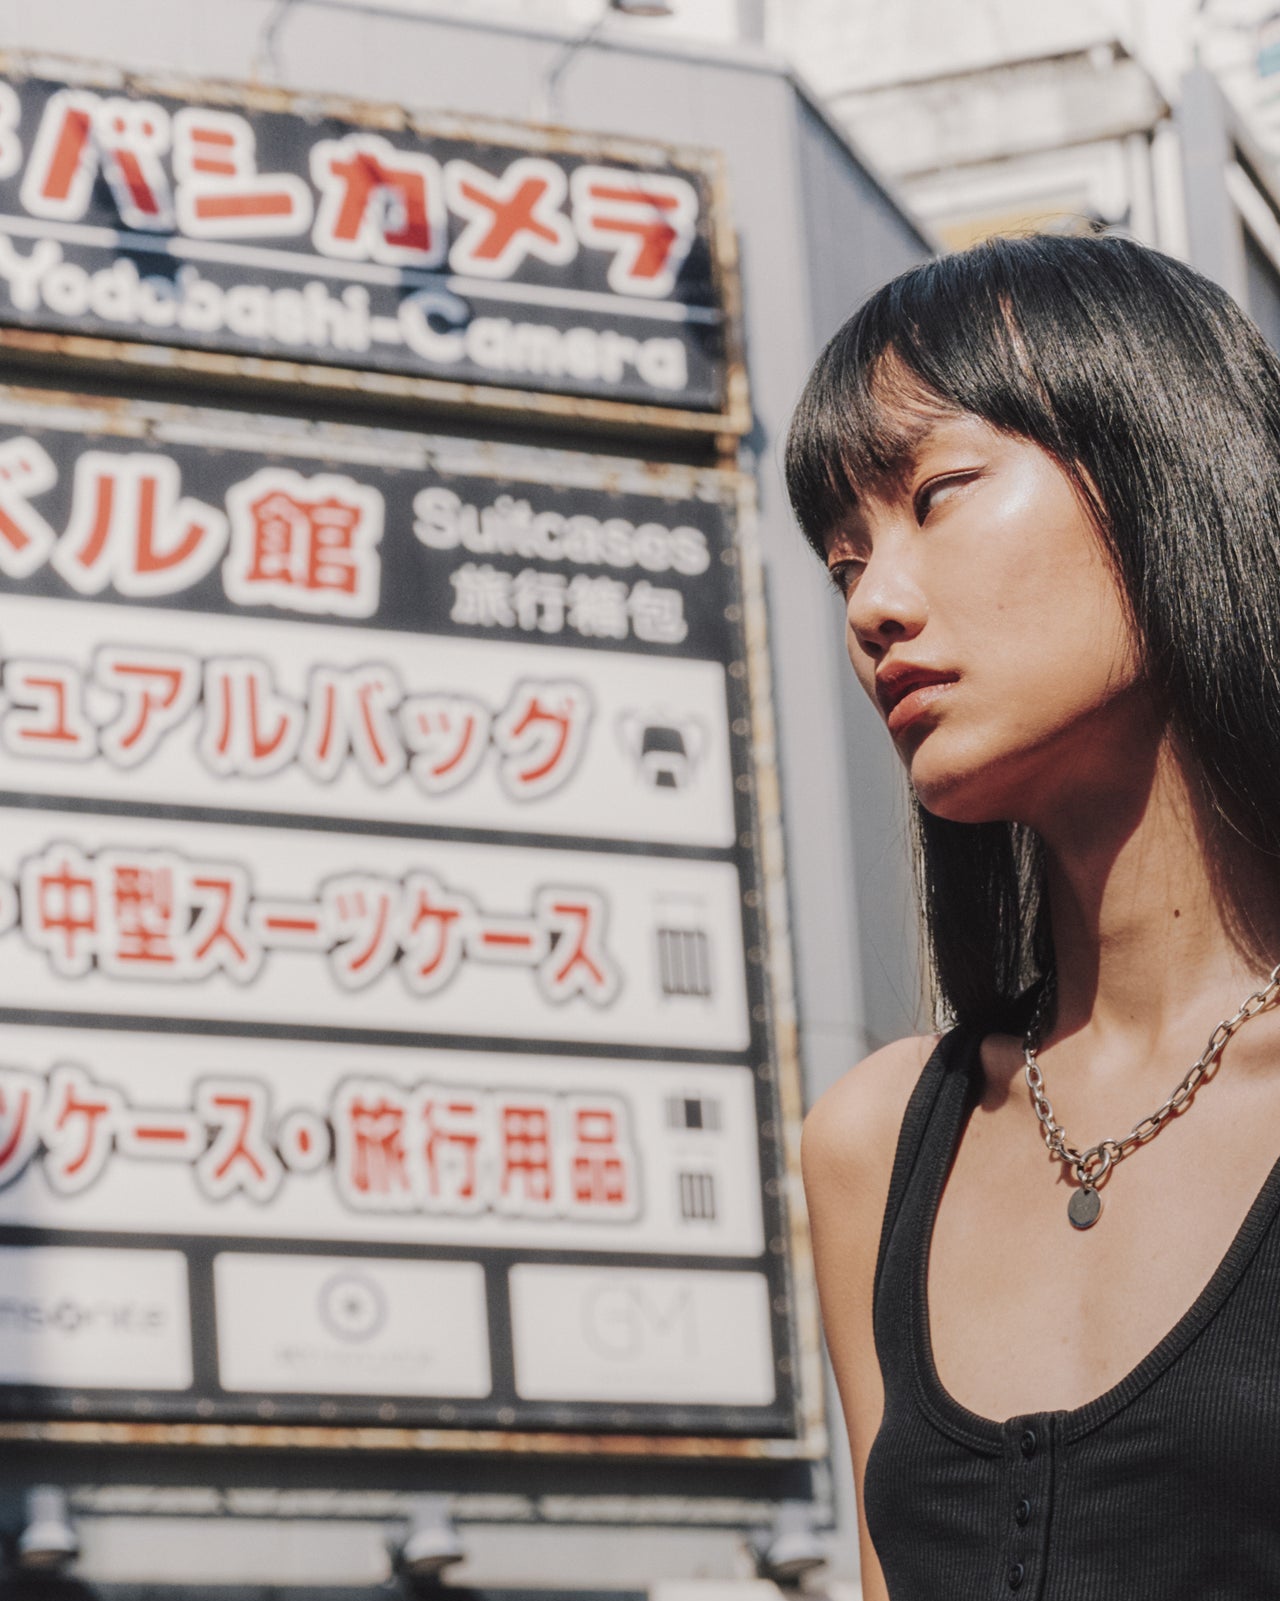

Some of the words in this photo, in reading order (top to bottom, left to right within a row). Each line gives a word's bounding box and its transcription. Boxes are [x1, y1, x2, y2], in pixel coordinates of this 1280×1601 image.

[0, 82, 697, 296] バシカメラ
[0, 236, 688, 390] Yodobashi-Camera
[413, 487, 709, 574] Suitcases
